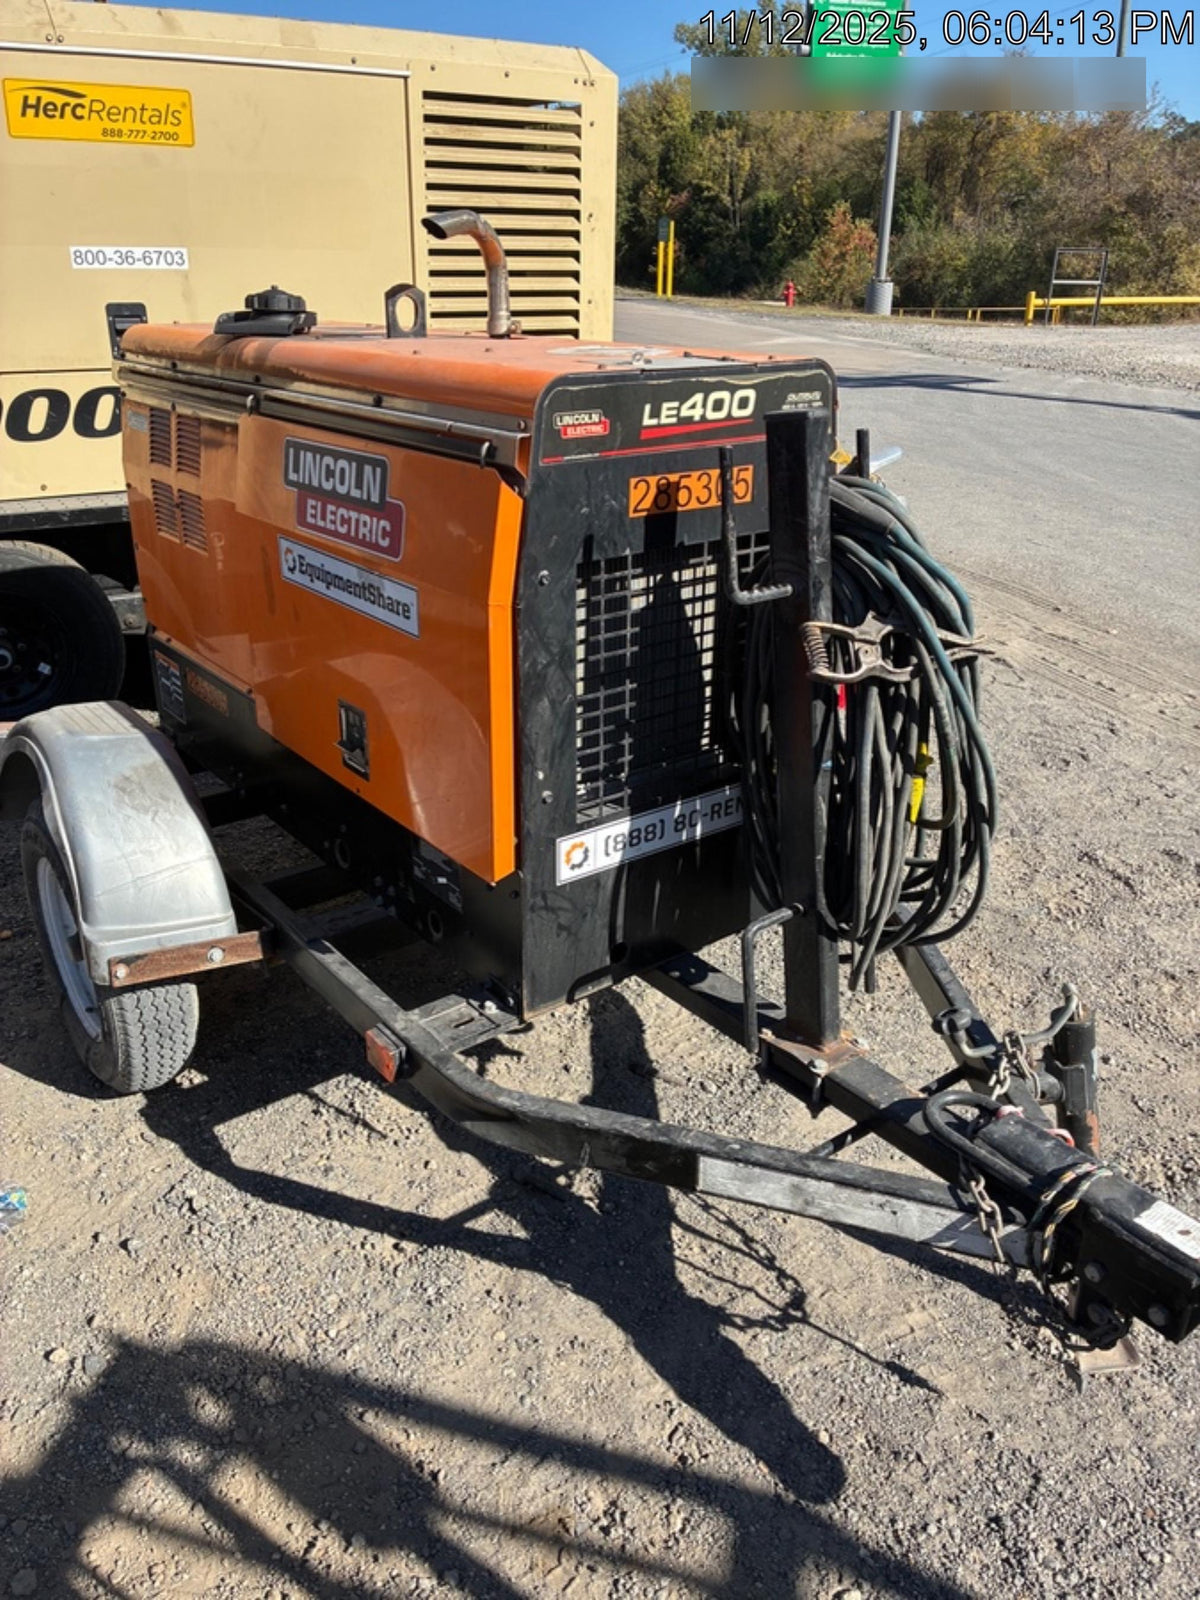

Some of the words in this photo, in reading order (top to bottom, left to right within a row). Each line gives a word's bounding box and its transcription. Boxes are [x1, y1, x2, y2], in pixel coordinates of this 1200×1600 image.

[101, 127, 179, 142] 888-777-2700
[73, 249, 186, 266] 800-36-6703
[0, 386, 122, 442] 00
[556, 413, 600, 426] LINCOLN
[642, 388, 757, 427] LE400
[566, 424, 605, 437] ELECTRIC
[288, 447, 381, 504] LINCOLN
[306, 498, 391, 547] ELECTRIC
[298, 554, 411, 620] EquipmentShare
[604, 818, 665, 857] (888)
